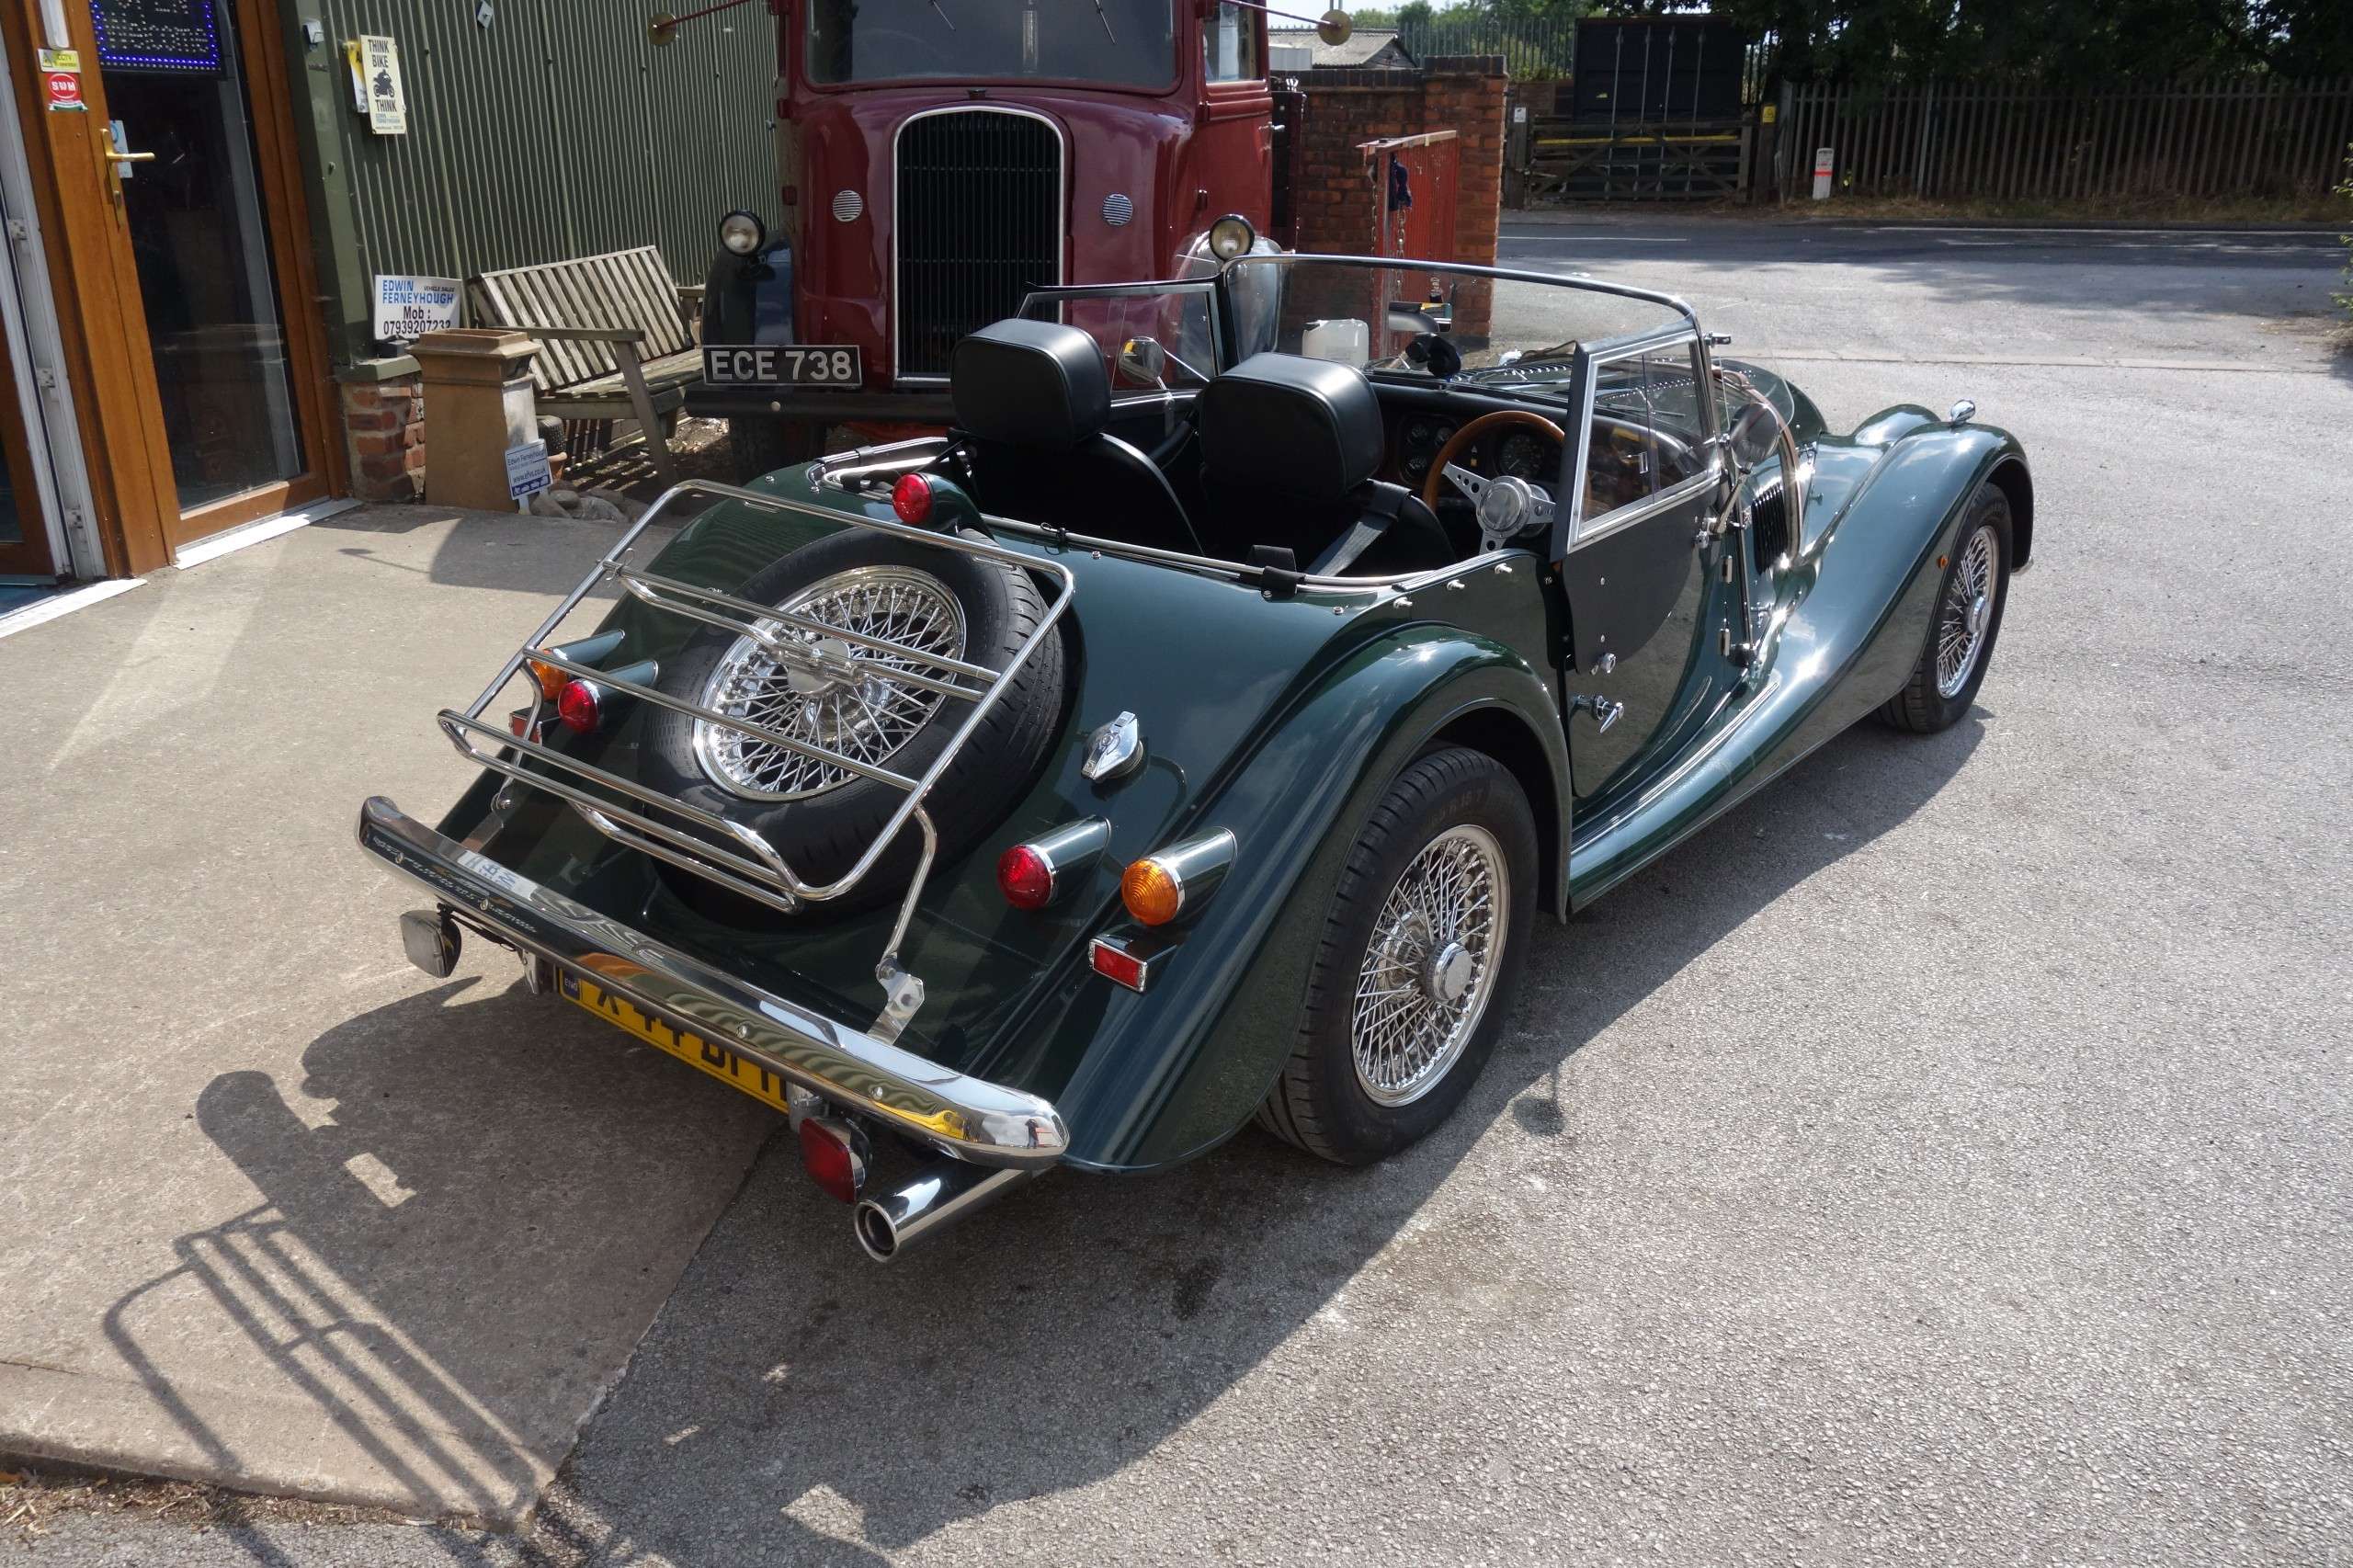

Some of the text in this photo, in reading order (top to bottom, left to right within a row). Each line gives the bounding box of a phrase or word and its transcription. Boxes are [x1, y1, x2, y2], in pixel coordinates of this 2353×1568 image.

[368, 40, 389, 53] THINK
[372, 55, 389, 68] BIKE
[375, 99, 397, 112] THINK
[382, 279, 414, 291] EDWIN
[382, 292, 454, 304] FERNEYHOUGH
[404, 306, 424, 320] Mob
[710, 350, 852, 381] ECE 738
